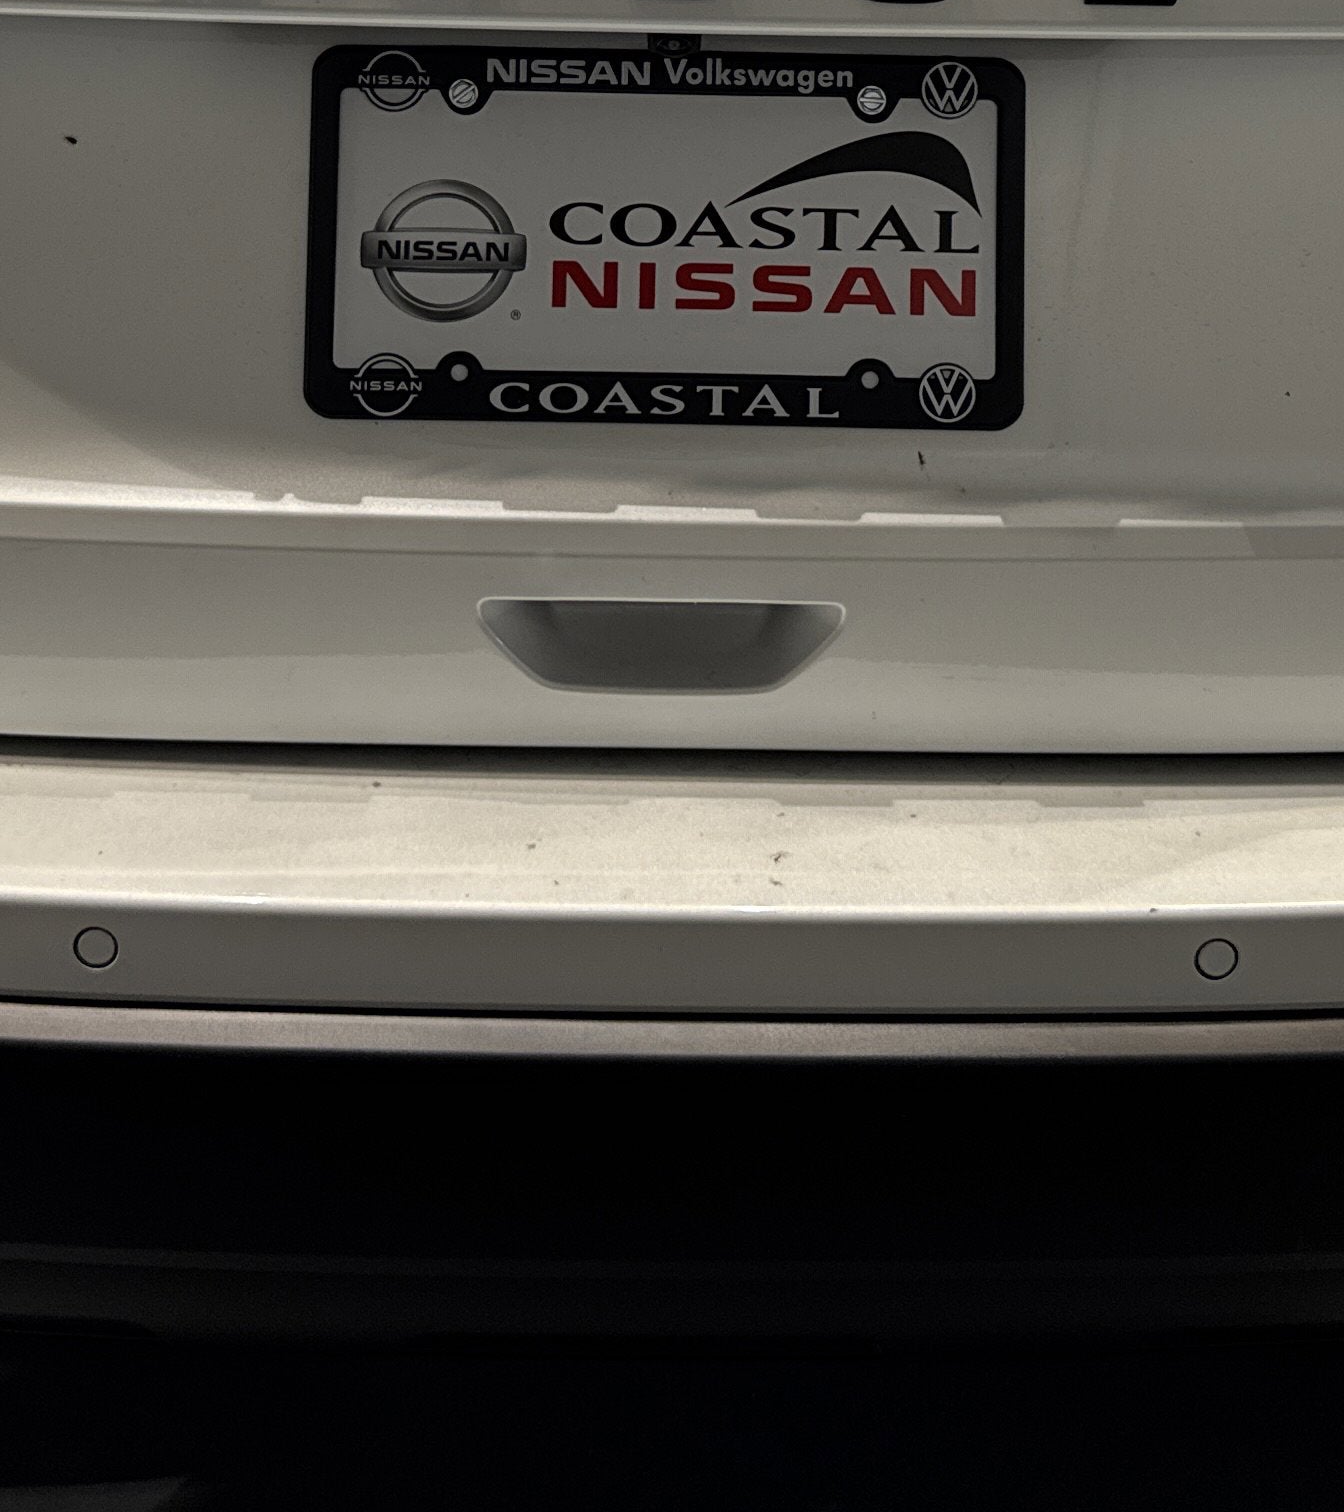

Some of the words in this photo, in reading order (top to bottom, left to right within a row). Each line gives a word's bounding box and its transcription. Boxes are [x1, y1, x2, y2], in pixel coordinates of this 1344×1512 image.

[358, 74, 431, 86] NISSAN
[486, 58, 652, 87] NISSAN
[663, 57, 855, 94] Volkswagen
[548, 199, 981, 255] COASTAL
[377, 237, 511, 264] NISSAN
[550, 259, 978, 318] NISSAN
[349, 379, 424, 393] NISSAN
[488, 381, 841, 421] COASTAL
